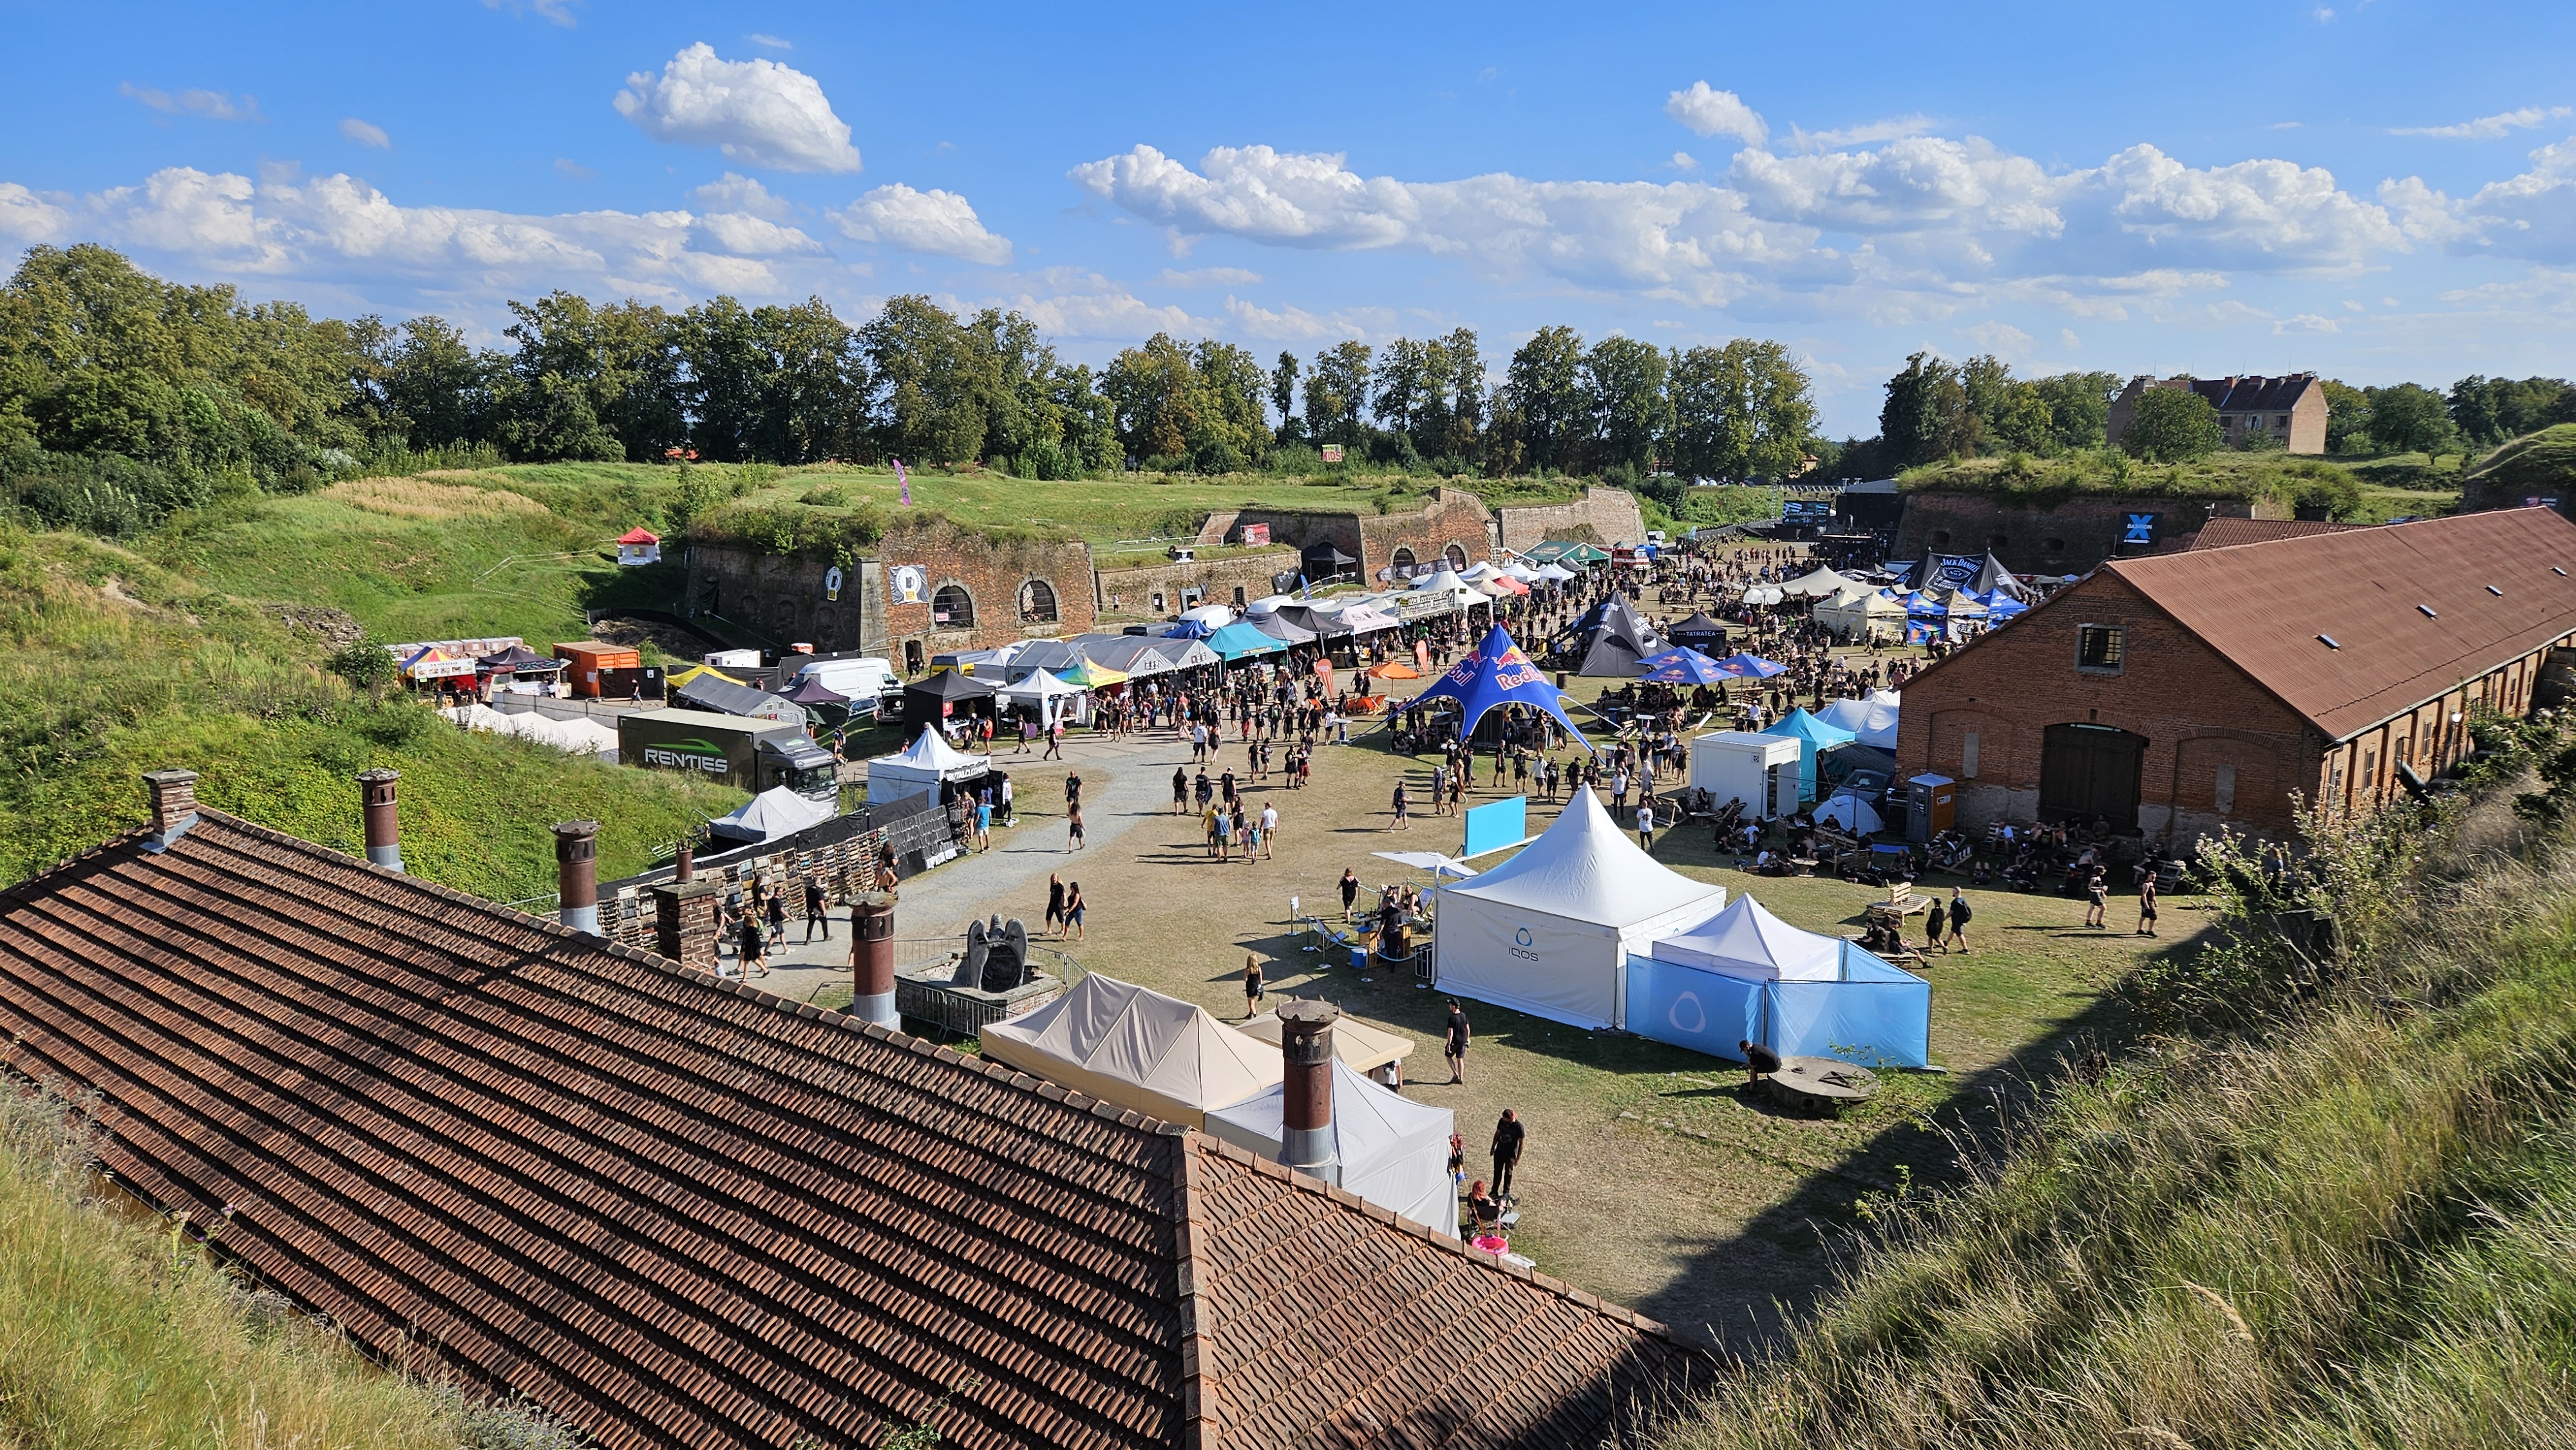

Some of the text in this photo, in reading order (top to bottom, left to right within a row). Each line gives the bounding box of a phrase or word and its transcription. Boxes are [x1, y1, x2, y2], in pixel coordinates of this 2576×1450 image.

[1323, 451, 1341, 461] KIDS
[1940, 558, 1958, 566] JACK
[1588, 623, 1615, 634] TATRATEA
[1446, 662, 1476, 687] Bull
[1495, 665, 1531, 691] Red
[645, 748, 728, 773] RENTIES
[1508, 946, 1539, 962] IQOS
